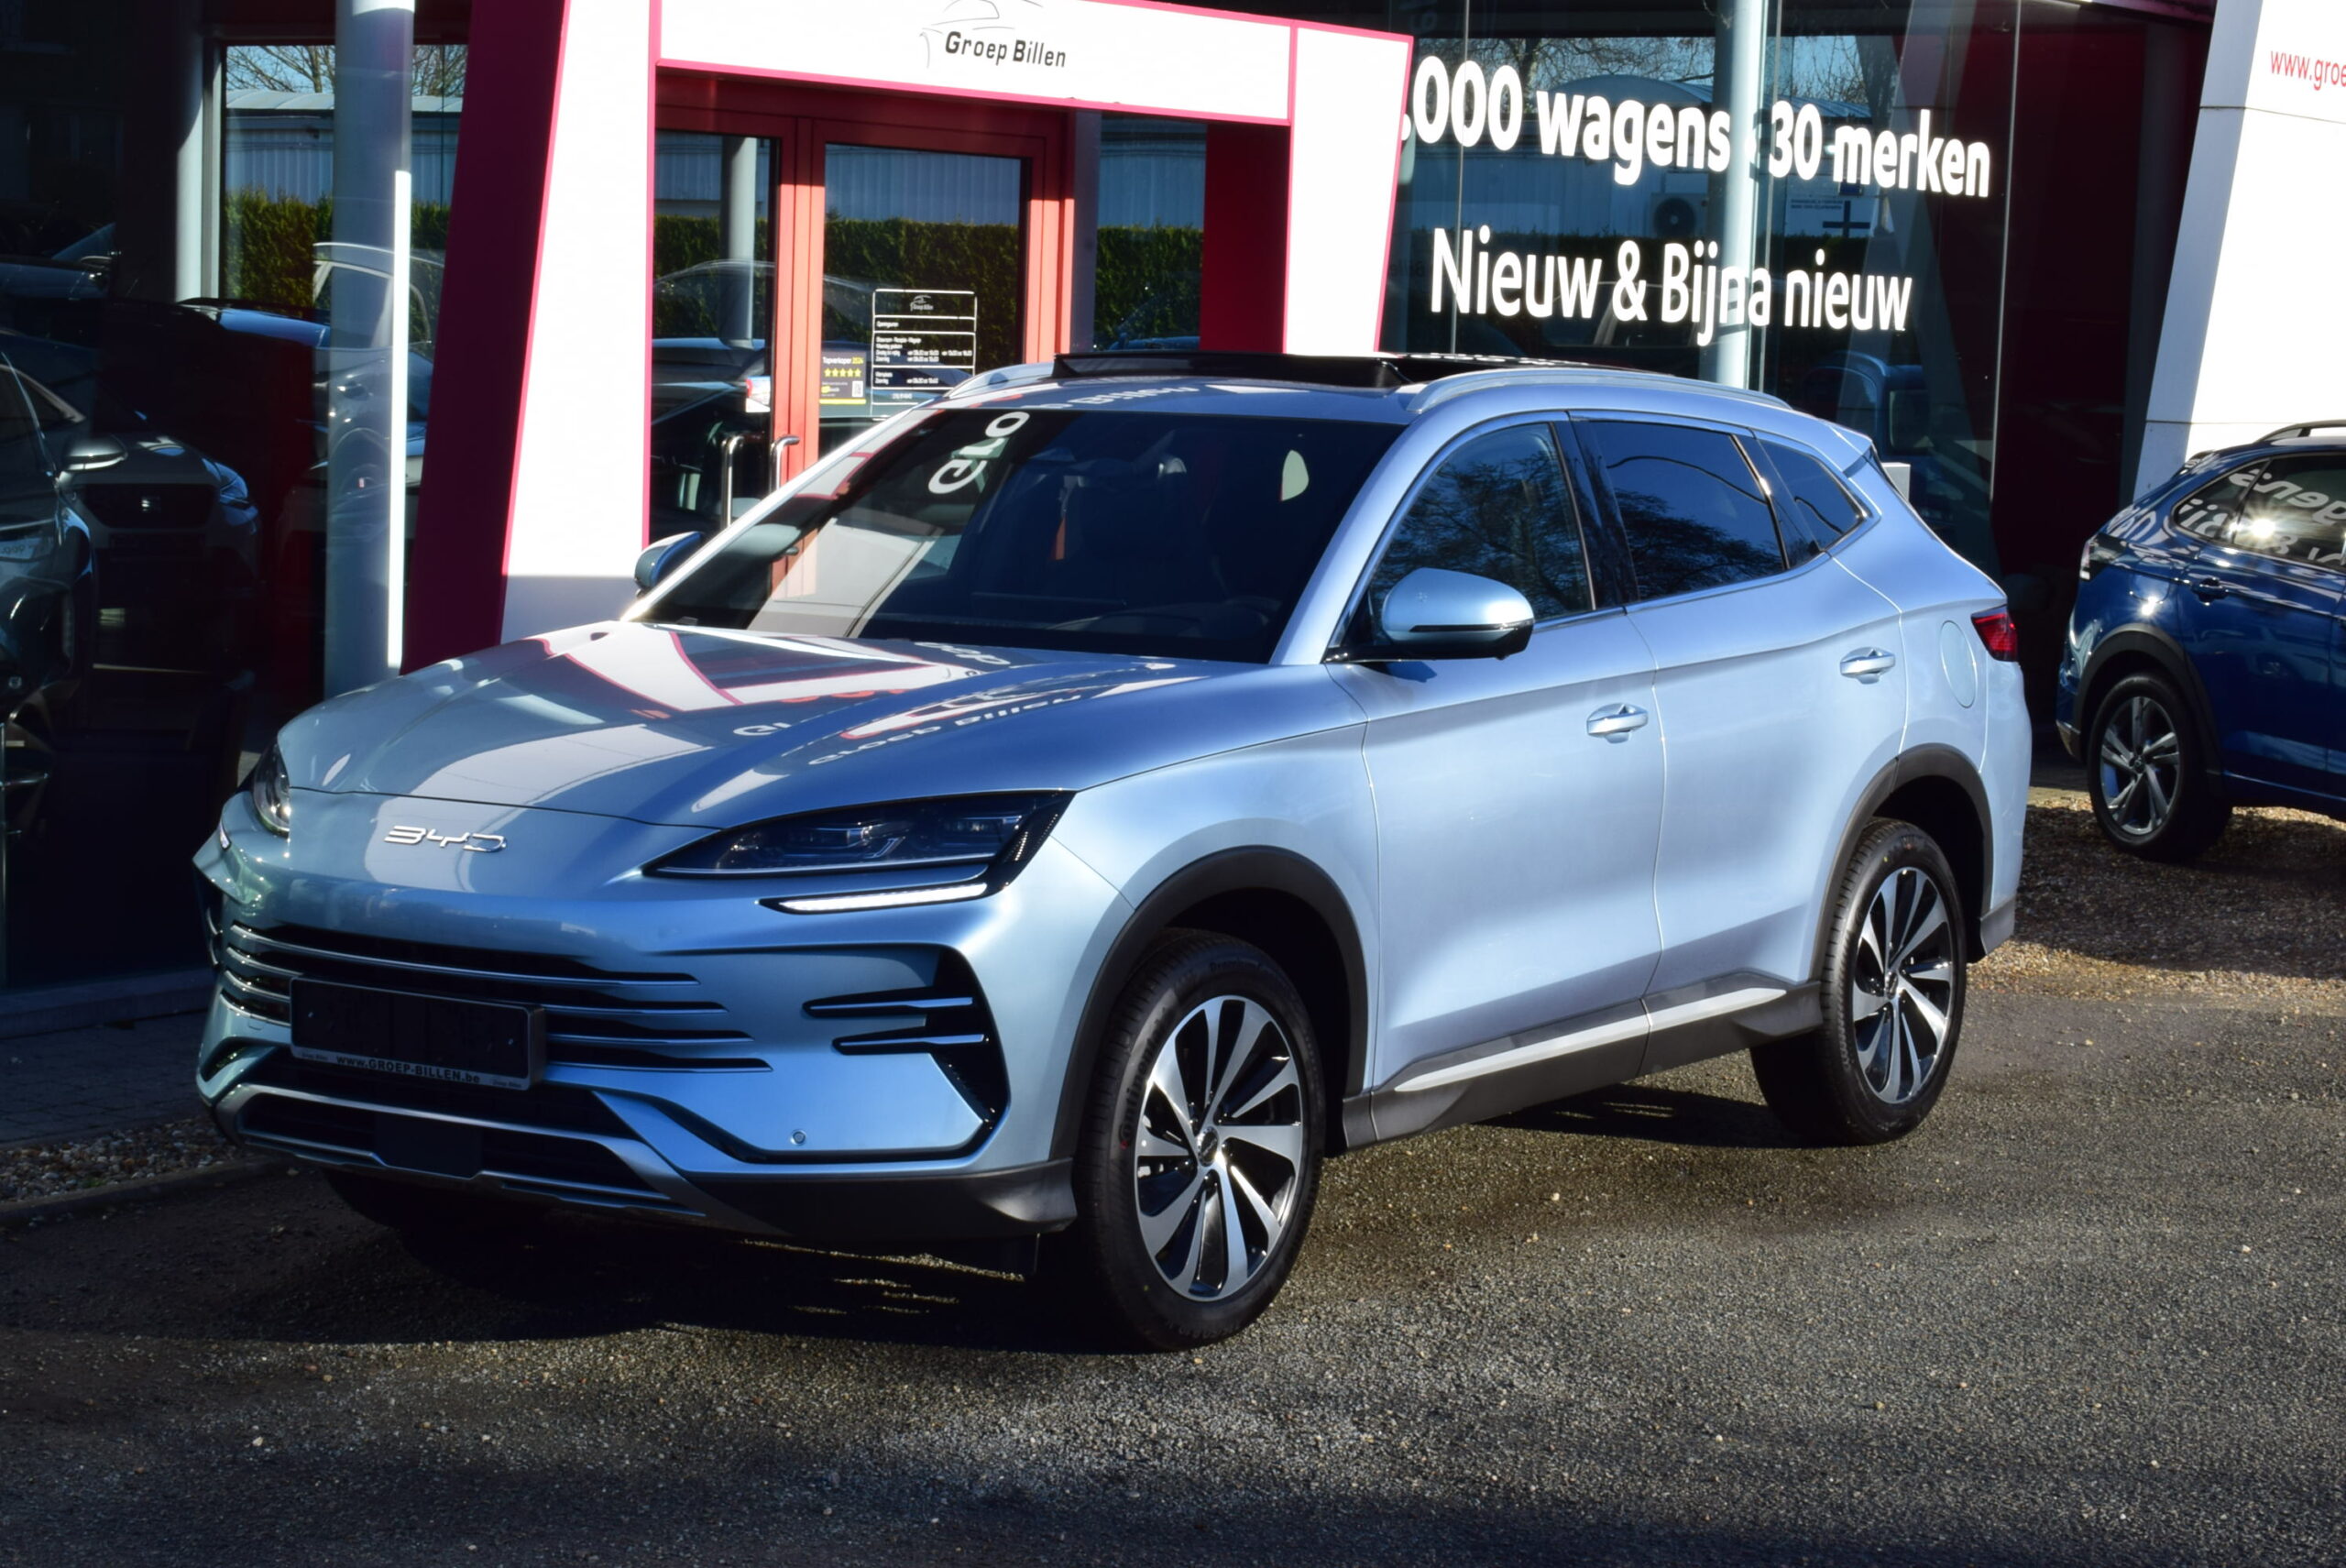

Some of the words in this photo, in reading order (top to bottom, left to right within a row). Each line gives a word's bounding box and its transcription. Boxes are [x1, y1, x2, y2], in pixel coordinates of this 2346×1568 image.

[945, 30, 1007, 66] Groep
[1013, 39, 1067, 68] Billen
[1536, 90, 1730, 185] wagens
[1769, 100, 1822, 181] 30
[1834, 108, 1990, 198] merken
[1431, 225, 1602, 318] Nieuw
[1612, 240, 1648, 322] &
[1661, 240, 1770, 346] Bijna
[1784, 248, 1913, 331] nieuw
[383, 825, 507, 853] BYD
[335, 1055, 481, 1084] www.GROEP-BILLEN.be
